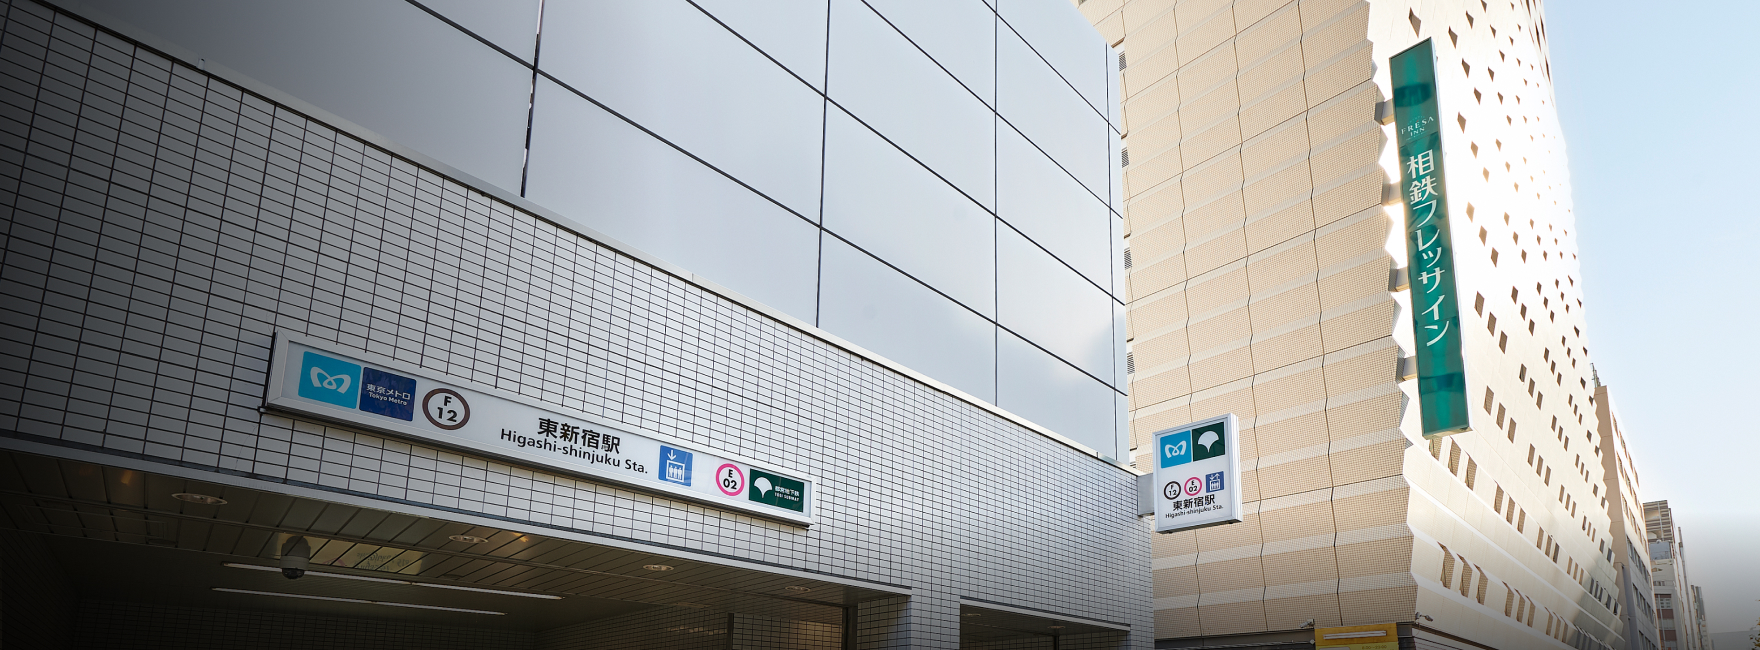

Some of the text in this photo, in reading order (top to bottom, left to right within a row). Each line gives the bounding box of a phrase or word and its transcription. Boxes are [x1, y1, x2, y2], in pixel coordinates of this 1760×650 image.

[1410, 127, 1425, 137] INN
[1407, 149, 1450, 347] 相鉄フレッサイン
[366, 383, 411, 400] 東京メトロ
[368, 391, 408, 406] Tokyo Metro
[444, 396, 452, 407] F
[437, 406, 458, 422] 12
[537, 417, 621, 454] 東新宿駅
[500, 428, 648, 474] Higashi-shinjuku Sta.
[728, 469, 733, 478] E
[723, 478, 737, 490] 02
[1172, 494, 1216, 511] 東新宿駅
[1165, 506, 1211, 519] Higashi-shinjuku
